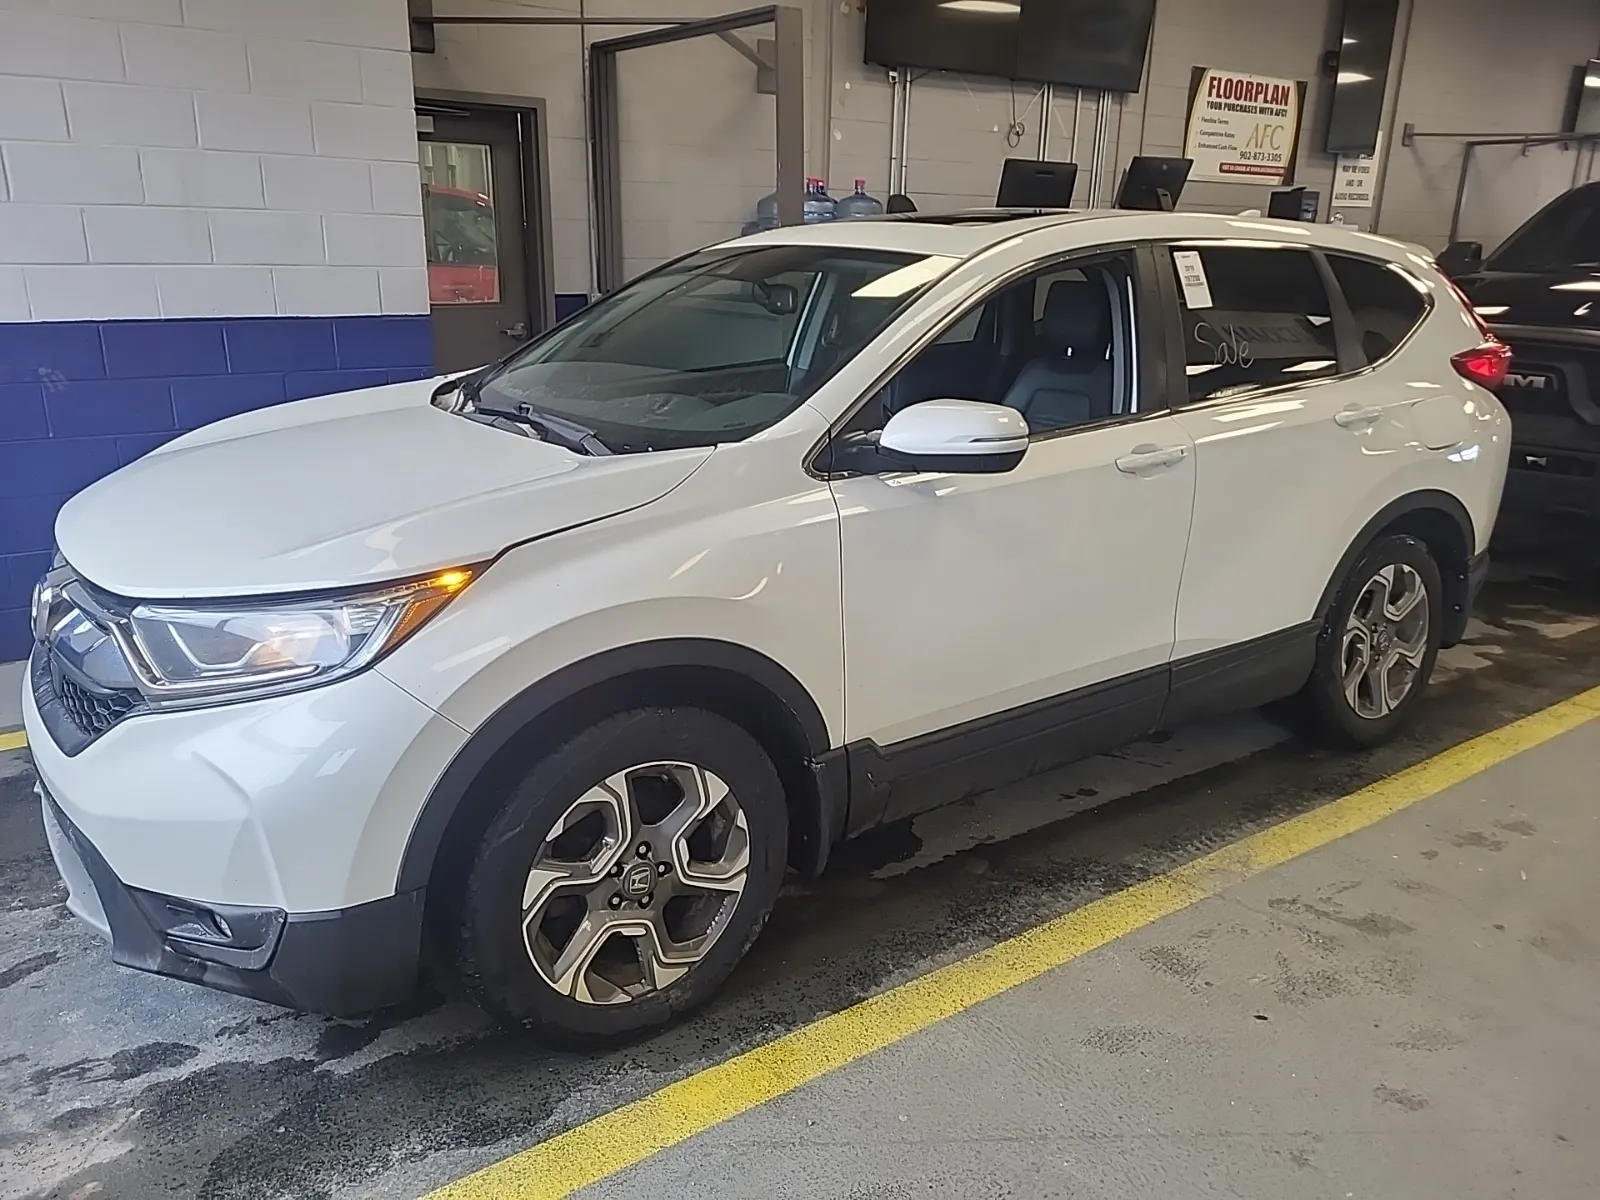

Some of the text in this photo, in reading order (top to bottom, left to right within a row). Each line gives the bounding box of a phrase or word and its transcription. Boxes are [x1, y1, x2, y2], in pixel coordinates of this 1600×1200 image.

[1207, 76, 1290, 106] FLOORPLAN
[1206, 100, 1222, 110] YOUR
[1223, 102, 1258, 114] PURCHASES
[1259, 106, 1274, 116] WITH
[1245, 123, 1284, 150] AFC
[1239, 150, 1282, 162] 902-873-3305
